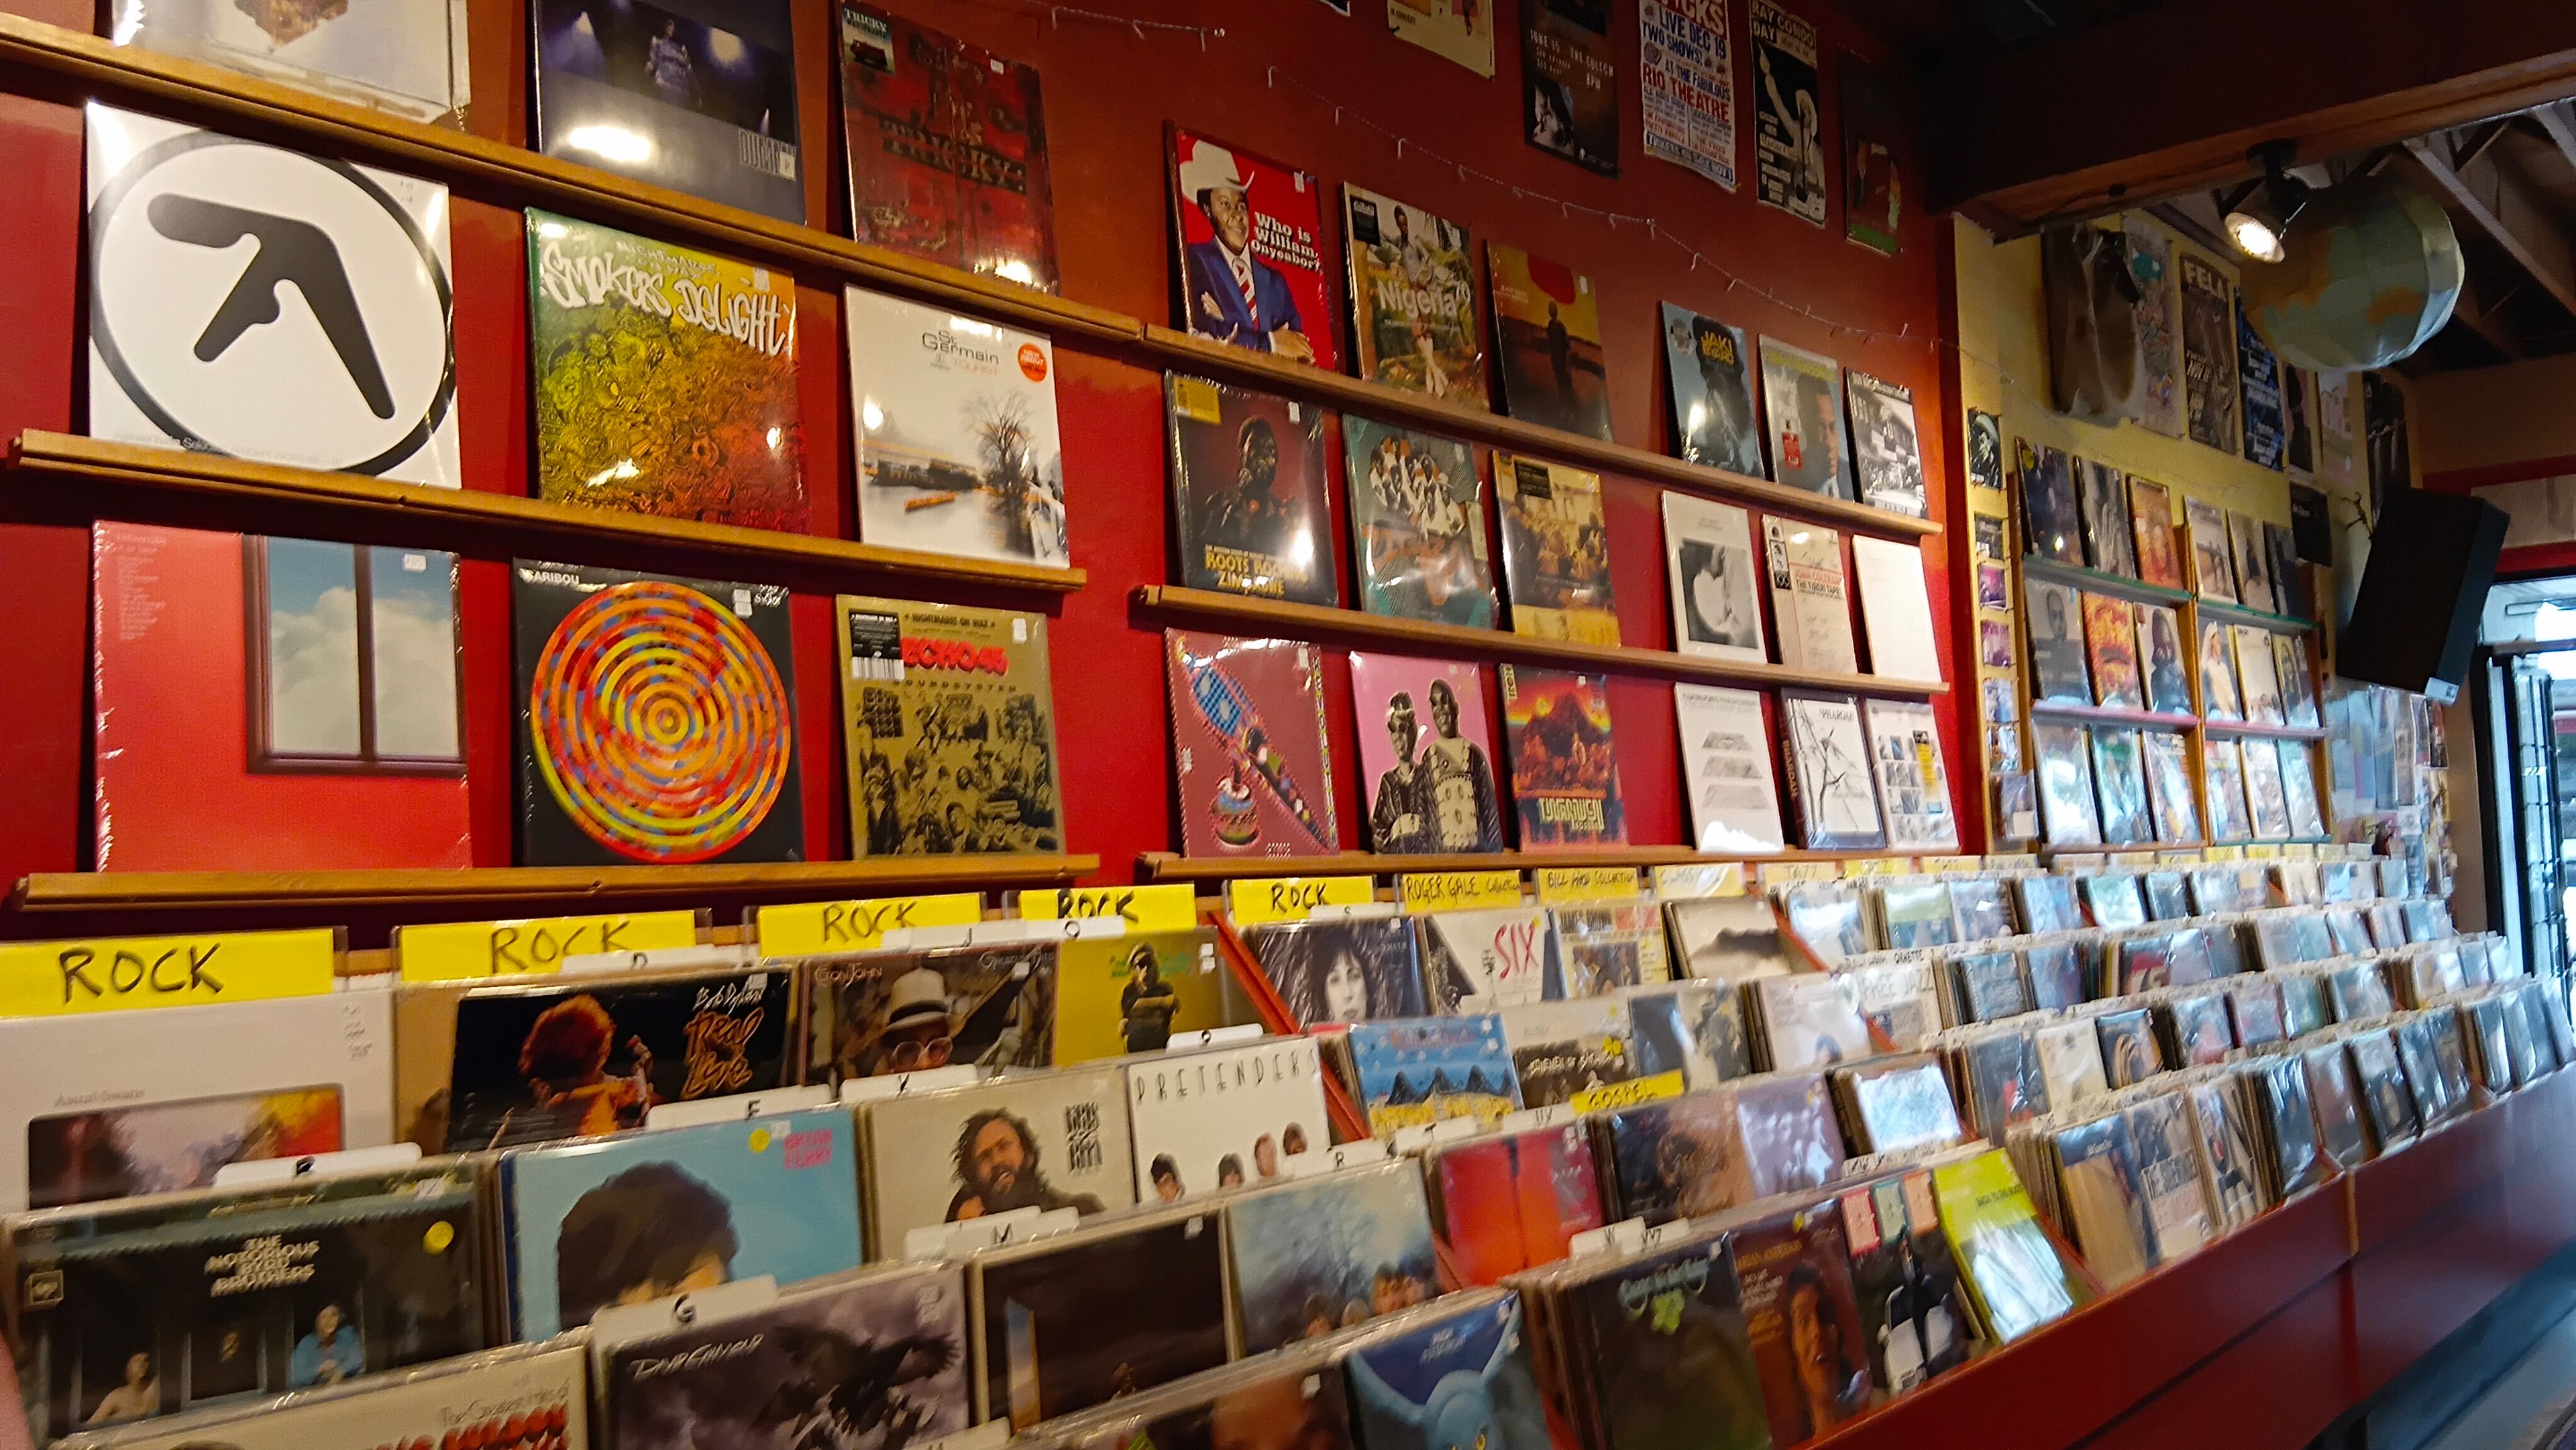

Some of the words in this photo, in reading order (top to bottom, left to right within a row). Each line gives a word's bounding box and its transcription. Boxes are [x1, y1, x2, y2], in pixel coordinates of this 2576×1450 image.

[1642, 20, 1664, 45] TWO
[1659, 5, 1685, 38] LIVE
[1689, 21, 1711, 52] DEC
[1715, 36, 1727, 60] 19
[1644, 62, 1666, 91] RIO
[1670, 76, 1729, 123] THEATRE
[1254, 211, 1292, 236] Who
[922, 332, 999, 364] Germain
[1206, 551, 1249, 574] ROOTS
[1270, 882, 1332, 913] ROCK
[1405, 874, 1446, 902] ROGER
[823, 900, 919, 943] ROCK
[1057, 888, 1140, 923] ROCK
[490, 919, 631, 975] ROCK
[1494, 921, 1540, 980] SIX
[59, 942, 225, 1006] ROCK
[692, 984, 726, 1012] Bob
[1136, 1047, 1318, 1104] PRETENDERS
[1589, 1080, 1658, 1109] GOSPEL
[994, 1223, 1014, 1246] M
[673, 1293, 698, 1326] G
